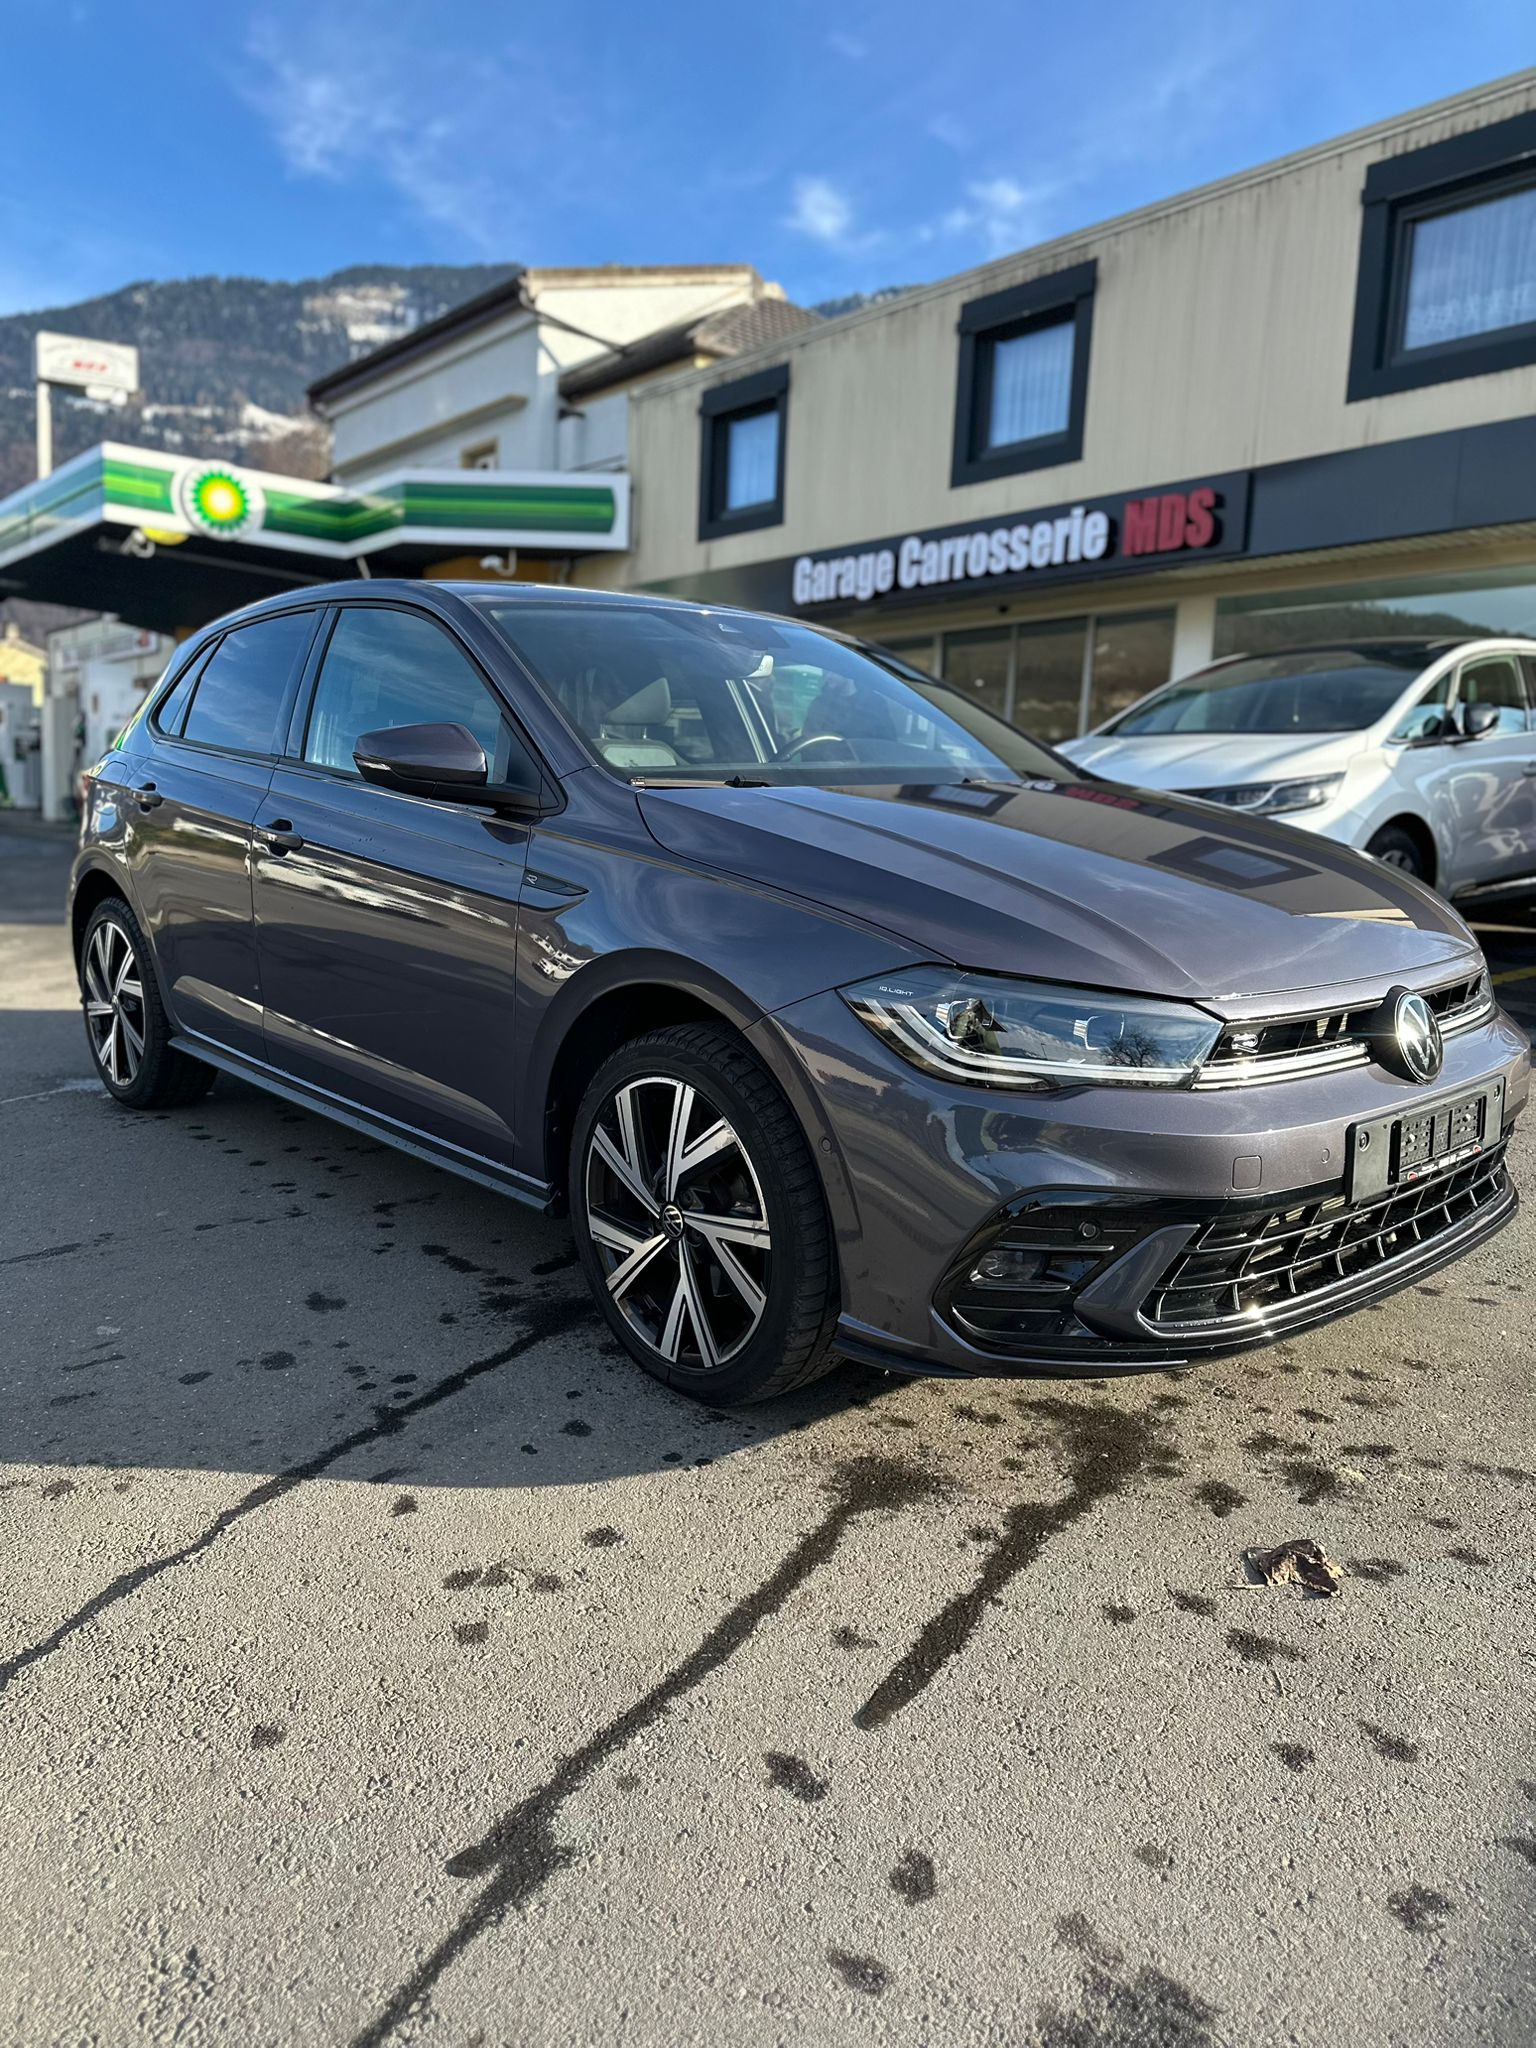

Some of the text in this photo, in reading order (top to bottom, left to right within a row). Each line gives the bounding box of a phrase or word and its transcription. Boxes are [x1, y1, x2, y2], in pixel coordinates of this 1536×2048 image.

[793, 487, 1216, 605] Garage Carrosserie MDS
[879, 985, 914, 996] IQ.LIGHT
